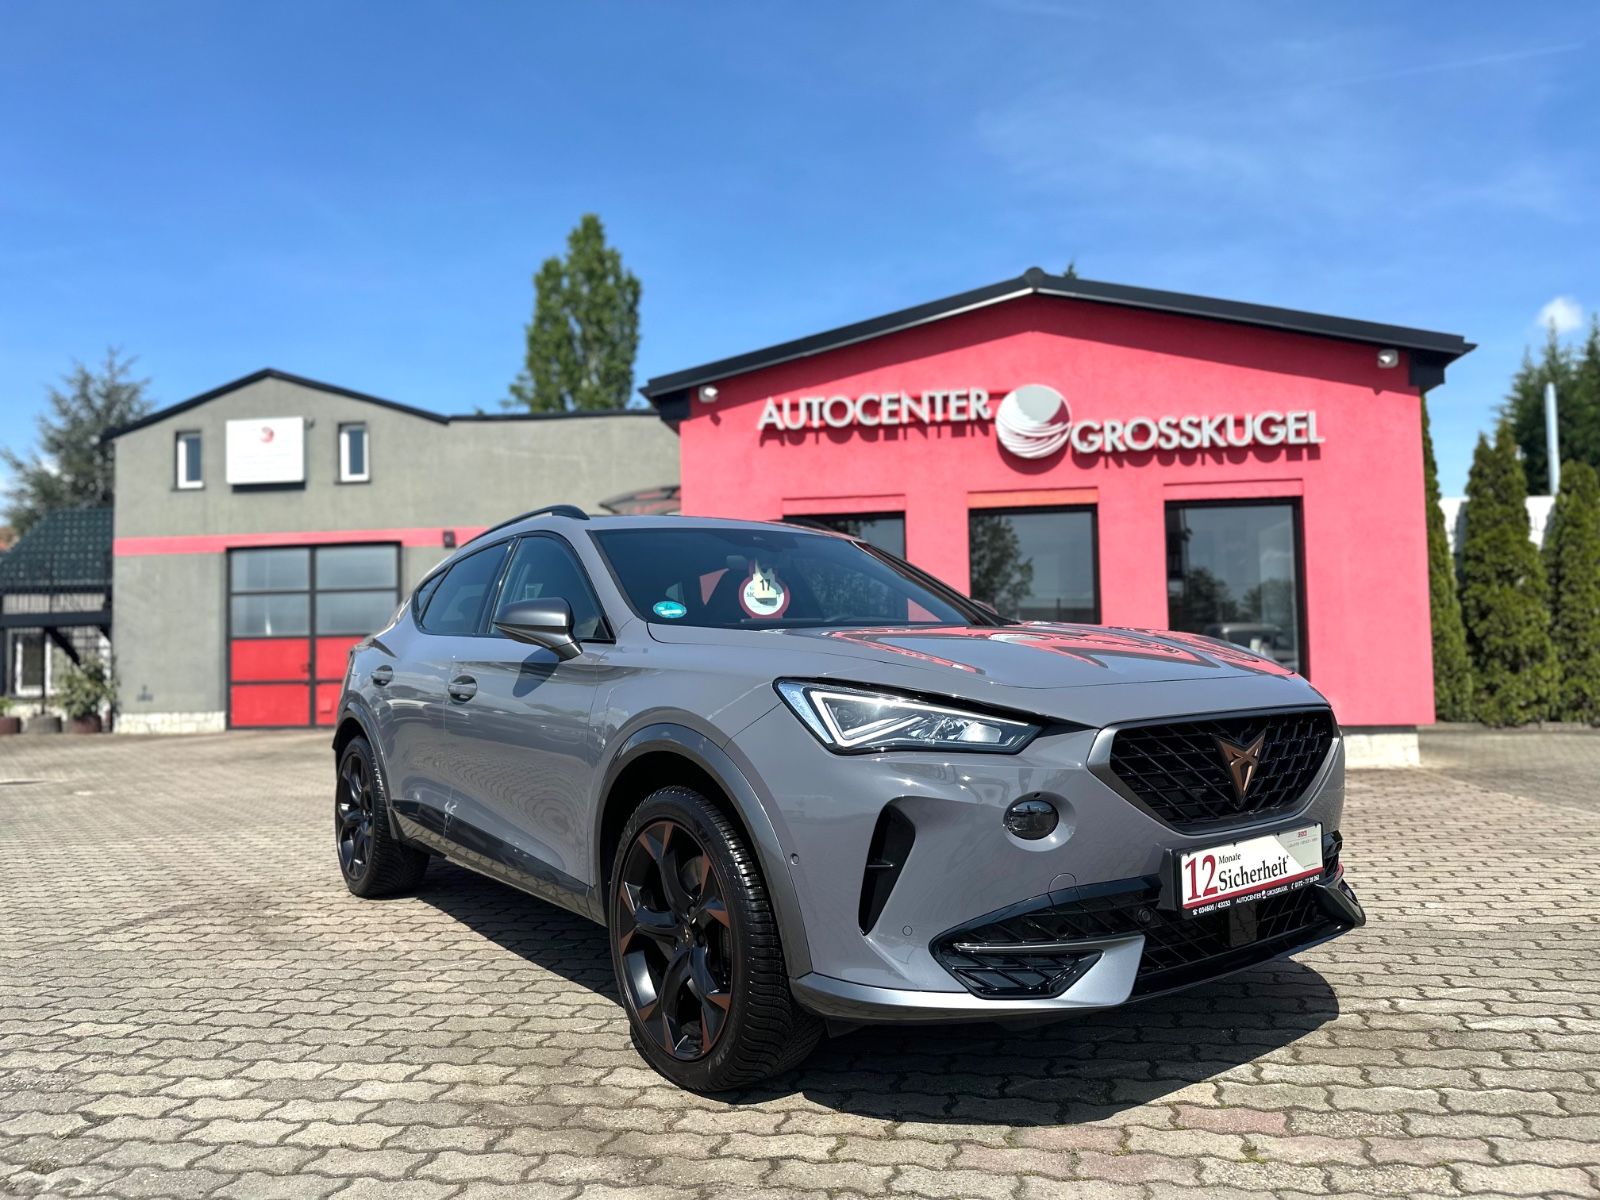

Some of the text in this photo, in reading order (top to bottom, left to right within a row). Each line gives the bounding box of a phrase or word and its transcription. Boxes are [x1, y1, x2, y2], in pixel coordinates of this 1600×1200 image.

[759, 388, 1325, 453] AUTOCENTER GROSSKUGEL
[1185, 854, 1218, 901] 12
[1218, 852, 1241, 865] Monate
